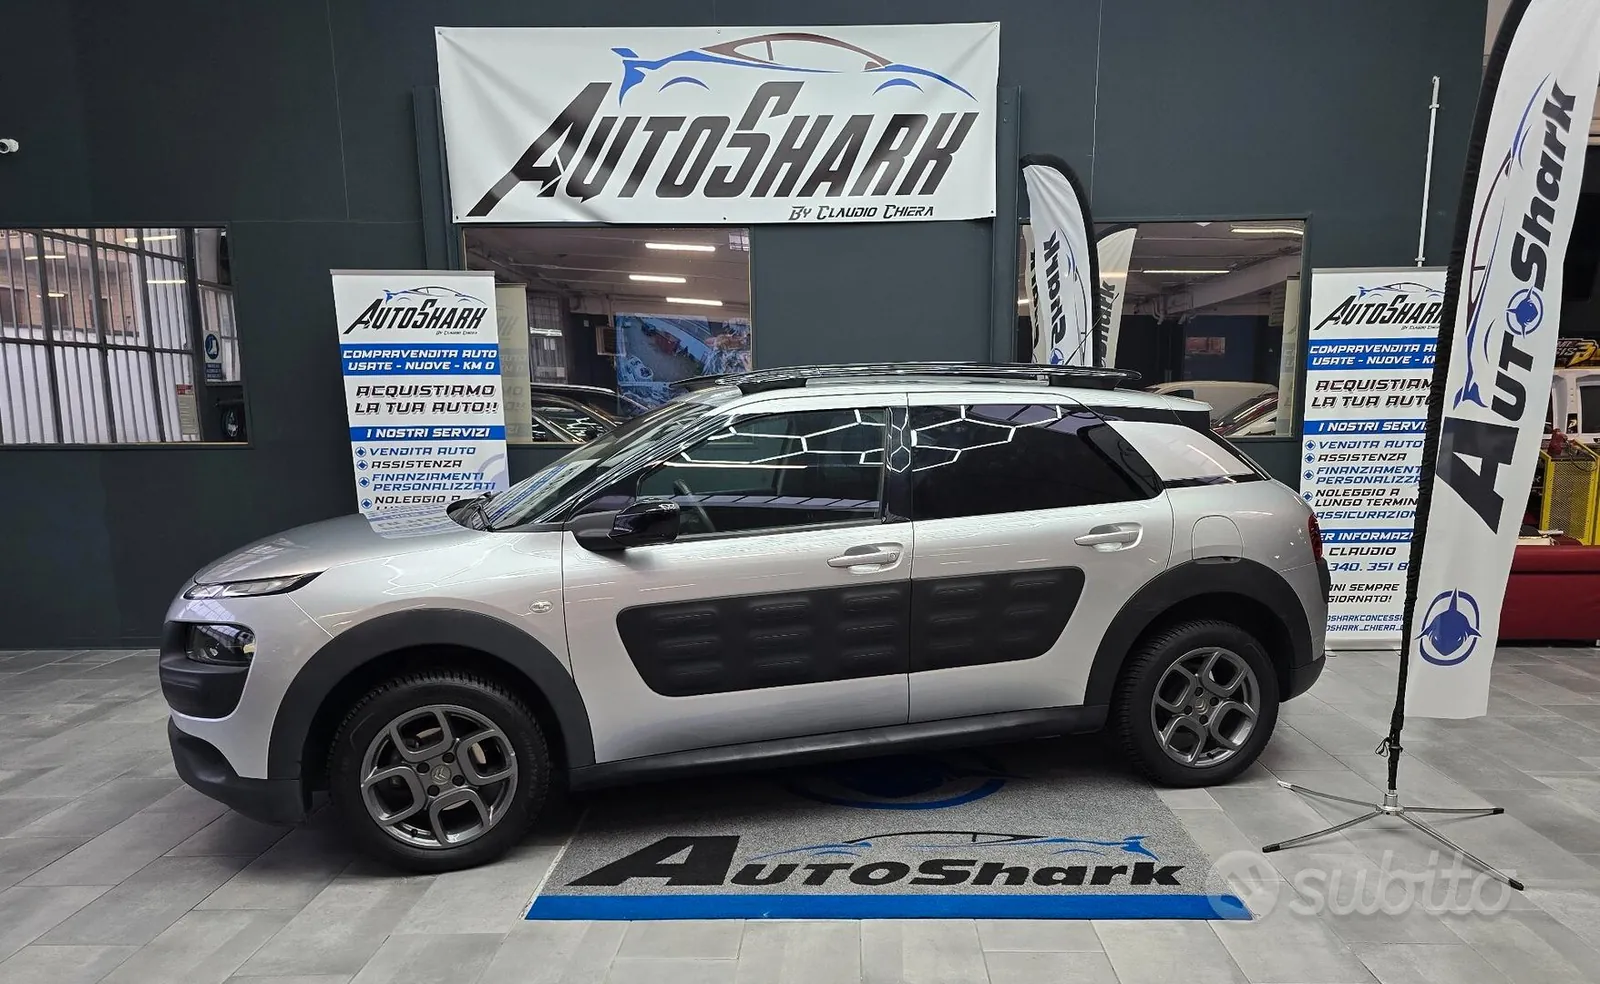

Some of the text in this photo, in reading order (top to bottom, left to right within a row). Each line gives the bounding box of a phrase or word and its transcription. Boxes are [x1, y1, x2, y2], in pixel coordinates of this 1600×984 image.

[883, 204, 934, 219] CHIERA
[1310, 344, 1419, 354] COMPRAVENDITA
[343, 350, 458, 359] COMPRAVENDITA
[462, 350, 497, 358] AUTO
[1312, 356, 1355, 366] USATE
[1366, 356, 1411, 365] NUOVE
[348, 361, 393, 371] USATE
[405, 361, 451, 370] NUOVE
[463, 361, 483, 370] KM
[1315, 378, 1433, 392] ACQUISTIAM
[356, 385, 495, 397] ACQUISTIAMO
[1311, 396, 1337, 407] LA
[1342, 395, 1380, 407] TUA
[355, 402, 379, 413] LA
[387, 402, 425, 413] TUA
[432, 401, 498, 413] AUTO!!
[1318, 421, 1426, 432] I NOSTRI SERVI
[366, 428, 490, 438] I NOSTRI SERVIZI
[1319, 440, 1423, 449] VENDITA AUTO
[370, 447, 476, 456] VENDITA AUTO
[1318, 453, 1407, 462] ASSISTENZA
[371, 460, 463, 469] ASSISTENZA
[1316, 466, 1421, 475] FINANZIAMENT
[372, 472, 484, 482] FINANZIAMENTI
[1315, 476, 1420, 485] PERSONALIZZA
[373, 482, 496, 491] PERSONALIZZATI
[1316, 488, 1400, 497] NOLEGGIO A
[375, 495, 446, 504] NOLEGGIO
[1315, 498, 1417, 507] LUNGO TERMIN
[1316, 511, 1416, 519] ASSICURAZION
[1320, 531, 1413, 541] ER INFORMAZI
[1329, 547, 1396, 556] CLAUDIO
[1367, 563, 1393, 571] 351
[1349, 583, 1400, 591] SEMPRE
[1328, 595, 1392, 603] GIORNATO!
